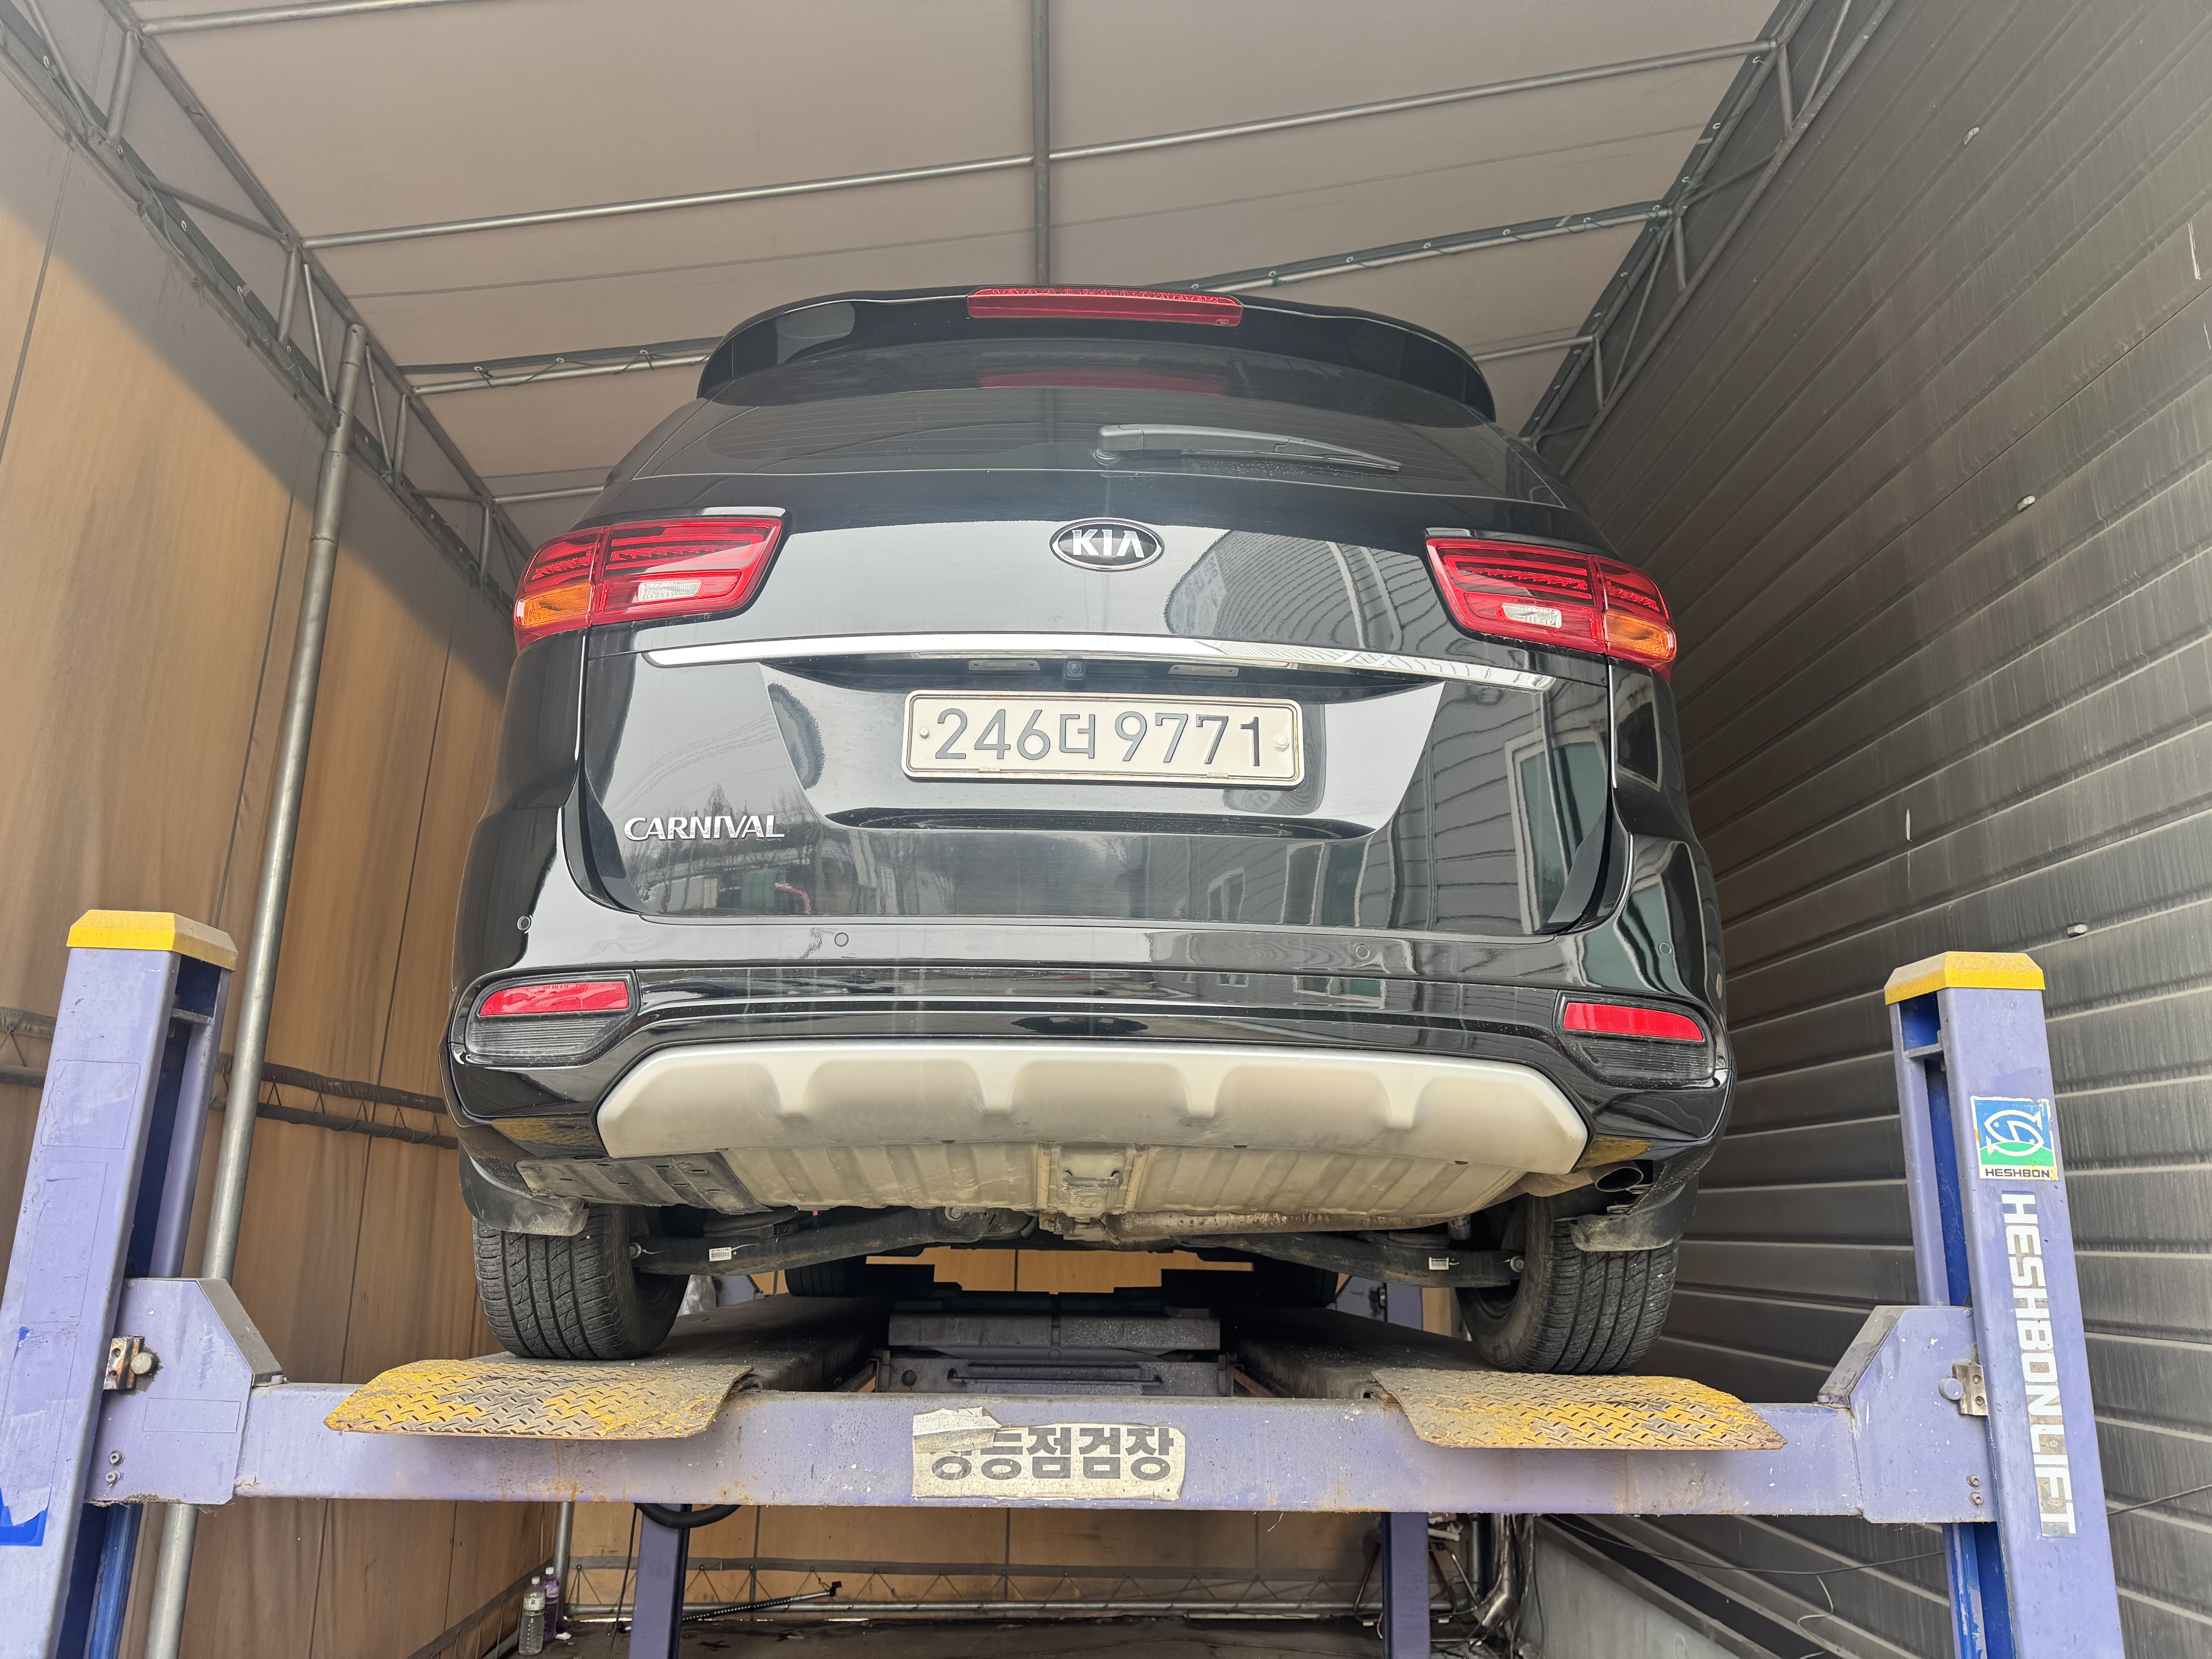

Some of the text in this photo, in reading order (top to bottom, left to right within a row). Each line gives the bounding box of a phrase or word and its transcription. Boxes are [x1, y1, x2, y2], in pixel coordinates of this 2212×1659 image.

[1072, 529, 1145, 558] KIA
[935, 708, 1260, 767] 246더 9771
[623, 814, 785, 841] CARNIVAL
[1985, 1168, 2050, 1178] HESHBON
